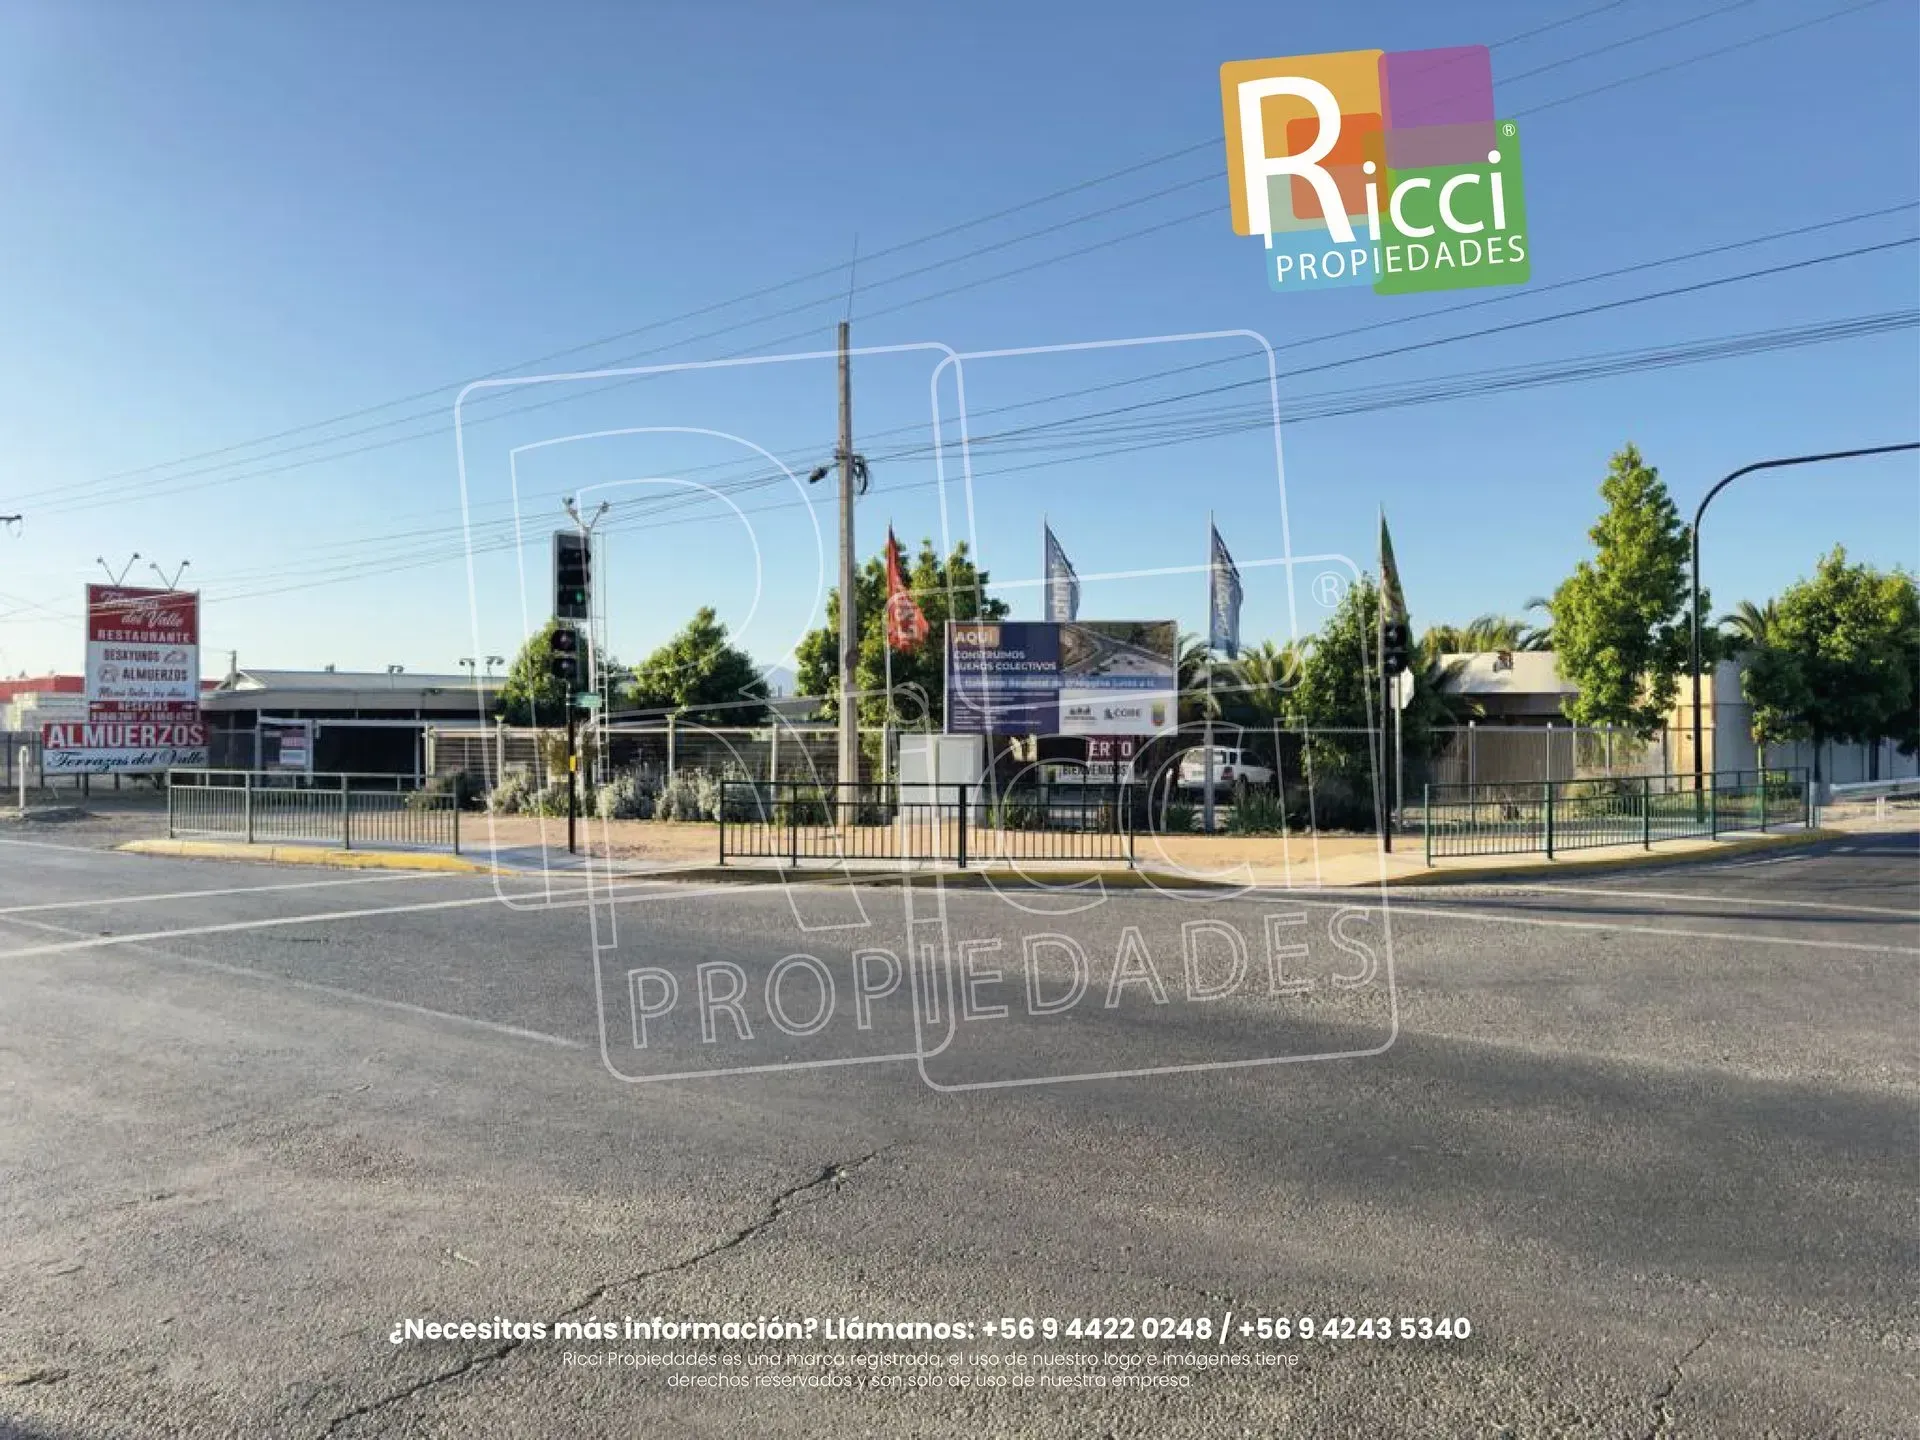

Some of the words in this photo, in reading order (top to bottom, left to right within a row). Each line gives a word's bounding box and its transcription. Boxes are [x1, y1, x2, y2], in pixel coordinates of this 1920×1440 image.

[97, 629, 191, 643] RESTAURANTE
[104, 648, 161, 663] DESAYUNOS
[954, 650, 1026, 660] CONSTRUIMOS
[996, 661, 1057, 671] COLECTIVOS
[123, 667, 187, 681] ALMUERZOS
[48, 722, 205, 749] ALMUERZOS
[46, 751, 129, 774] Terrazas
[130, 750, 156, 766] del
[158, 748, 205, 766] Valle
